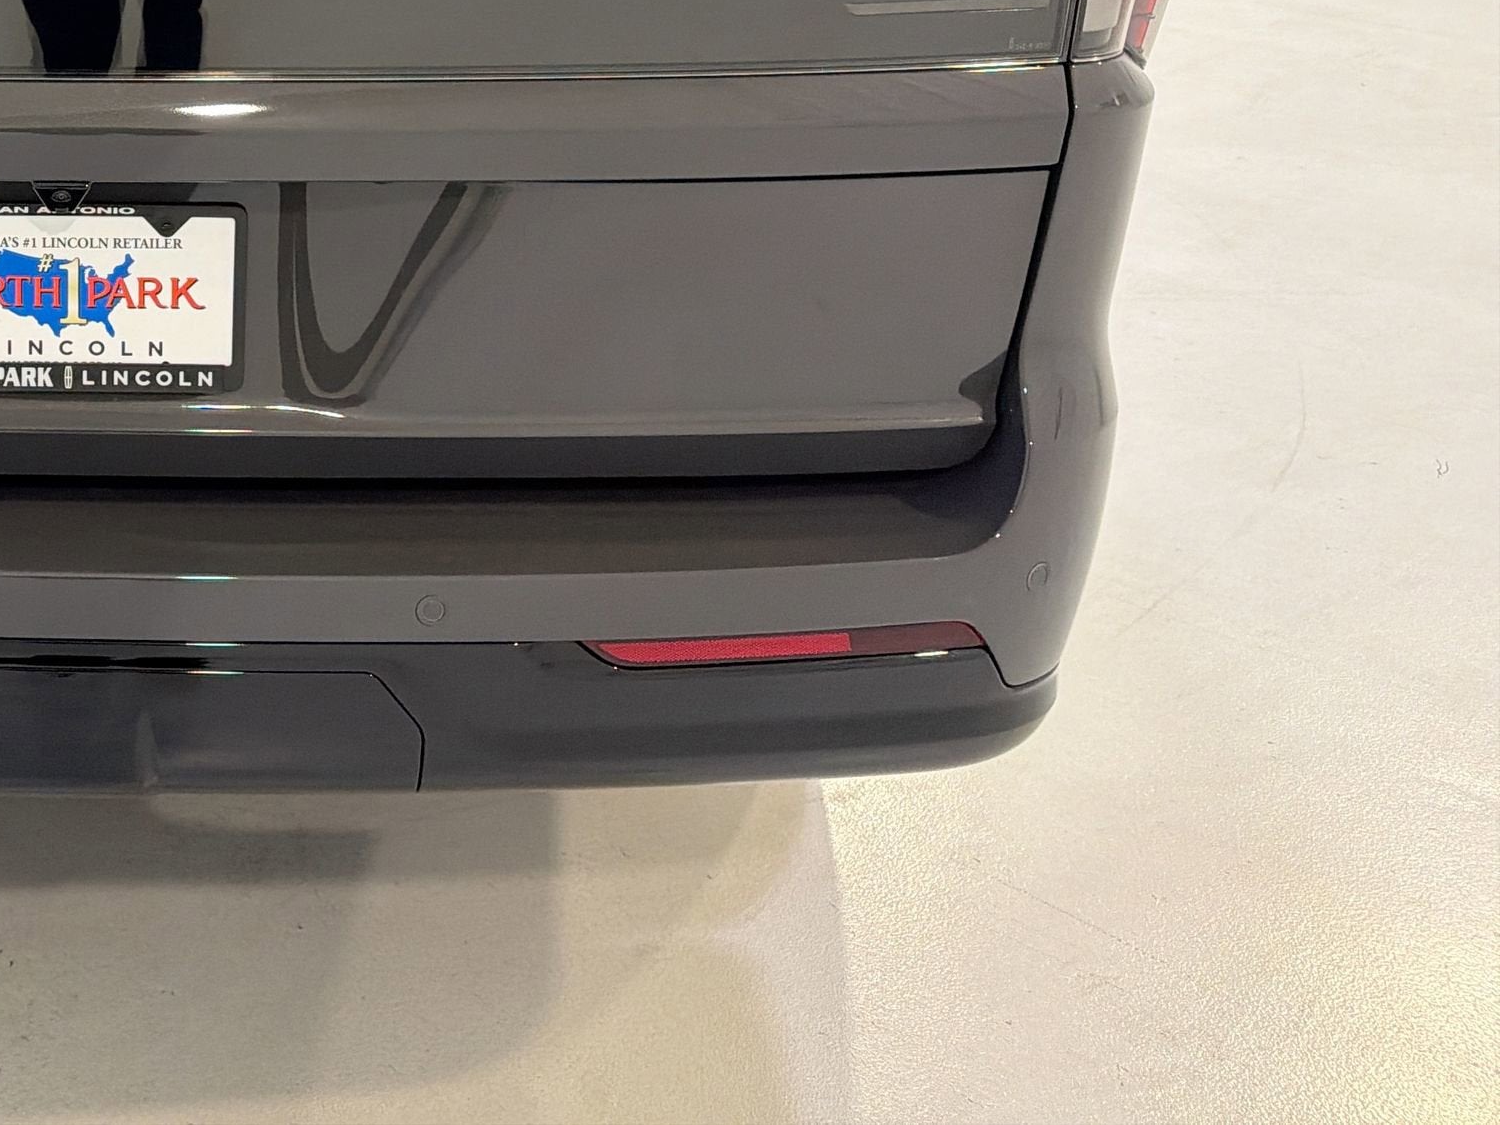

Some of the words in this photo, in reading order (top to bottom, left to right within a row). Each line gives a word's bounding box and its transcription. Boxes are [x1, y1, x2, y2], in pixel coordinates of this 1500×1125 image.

[23, 236, 37, 249] #1
[42, 236, 109, 250] LINCOLN
[113, 237, 183, 250] RETAILER
[87, 276, 207, 310] PARK
[82, 369, 214, 387] LINCOLN
